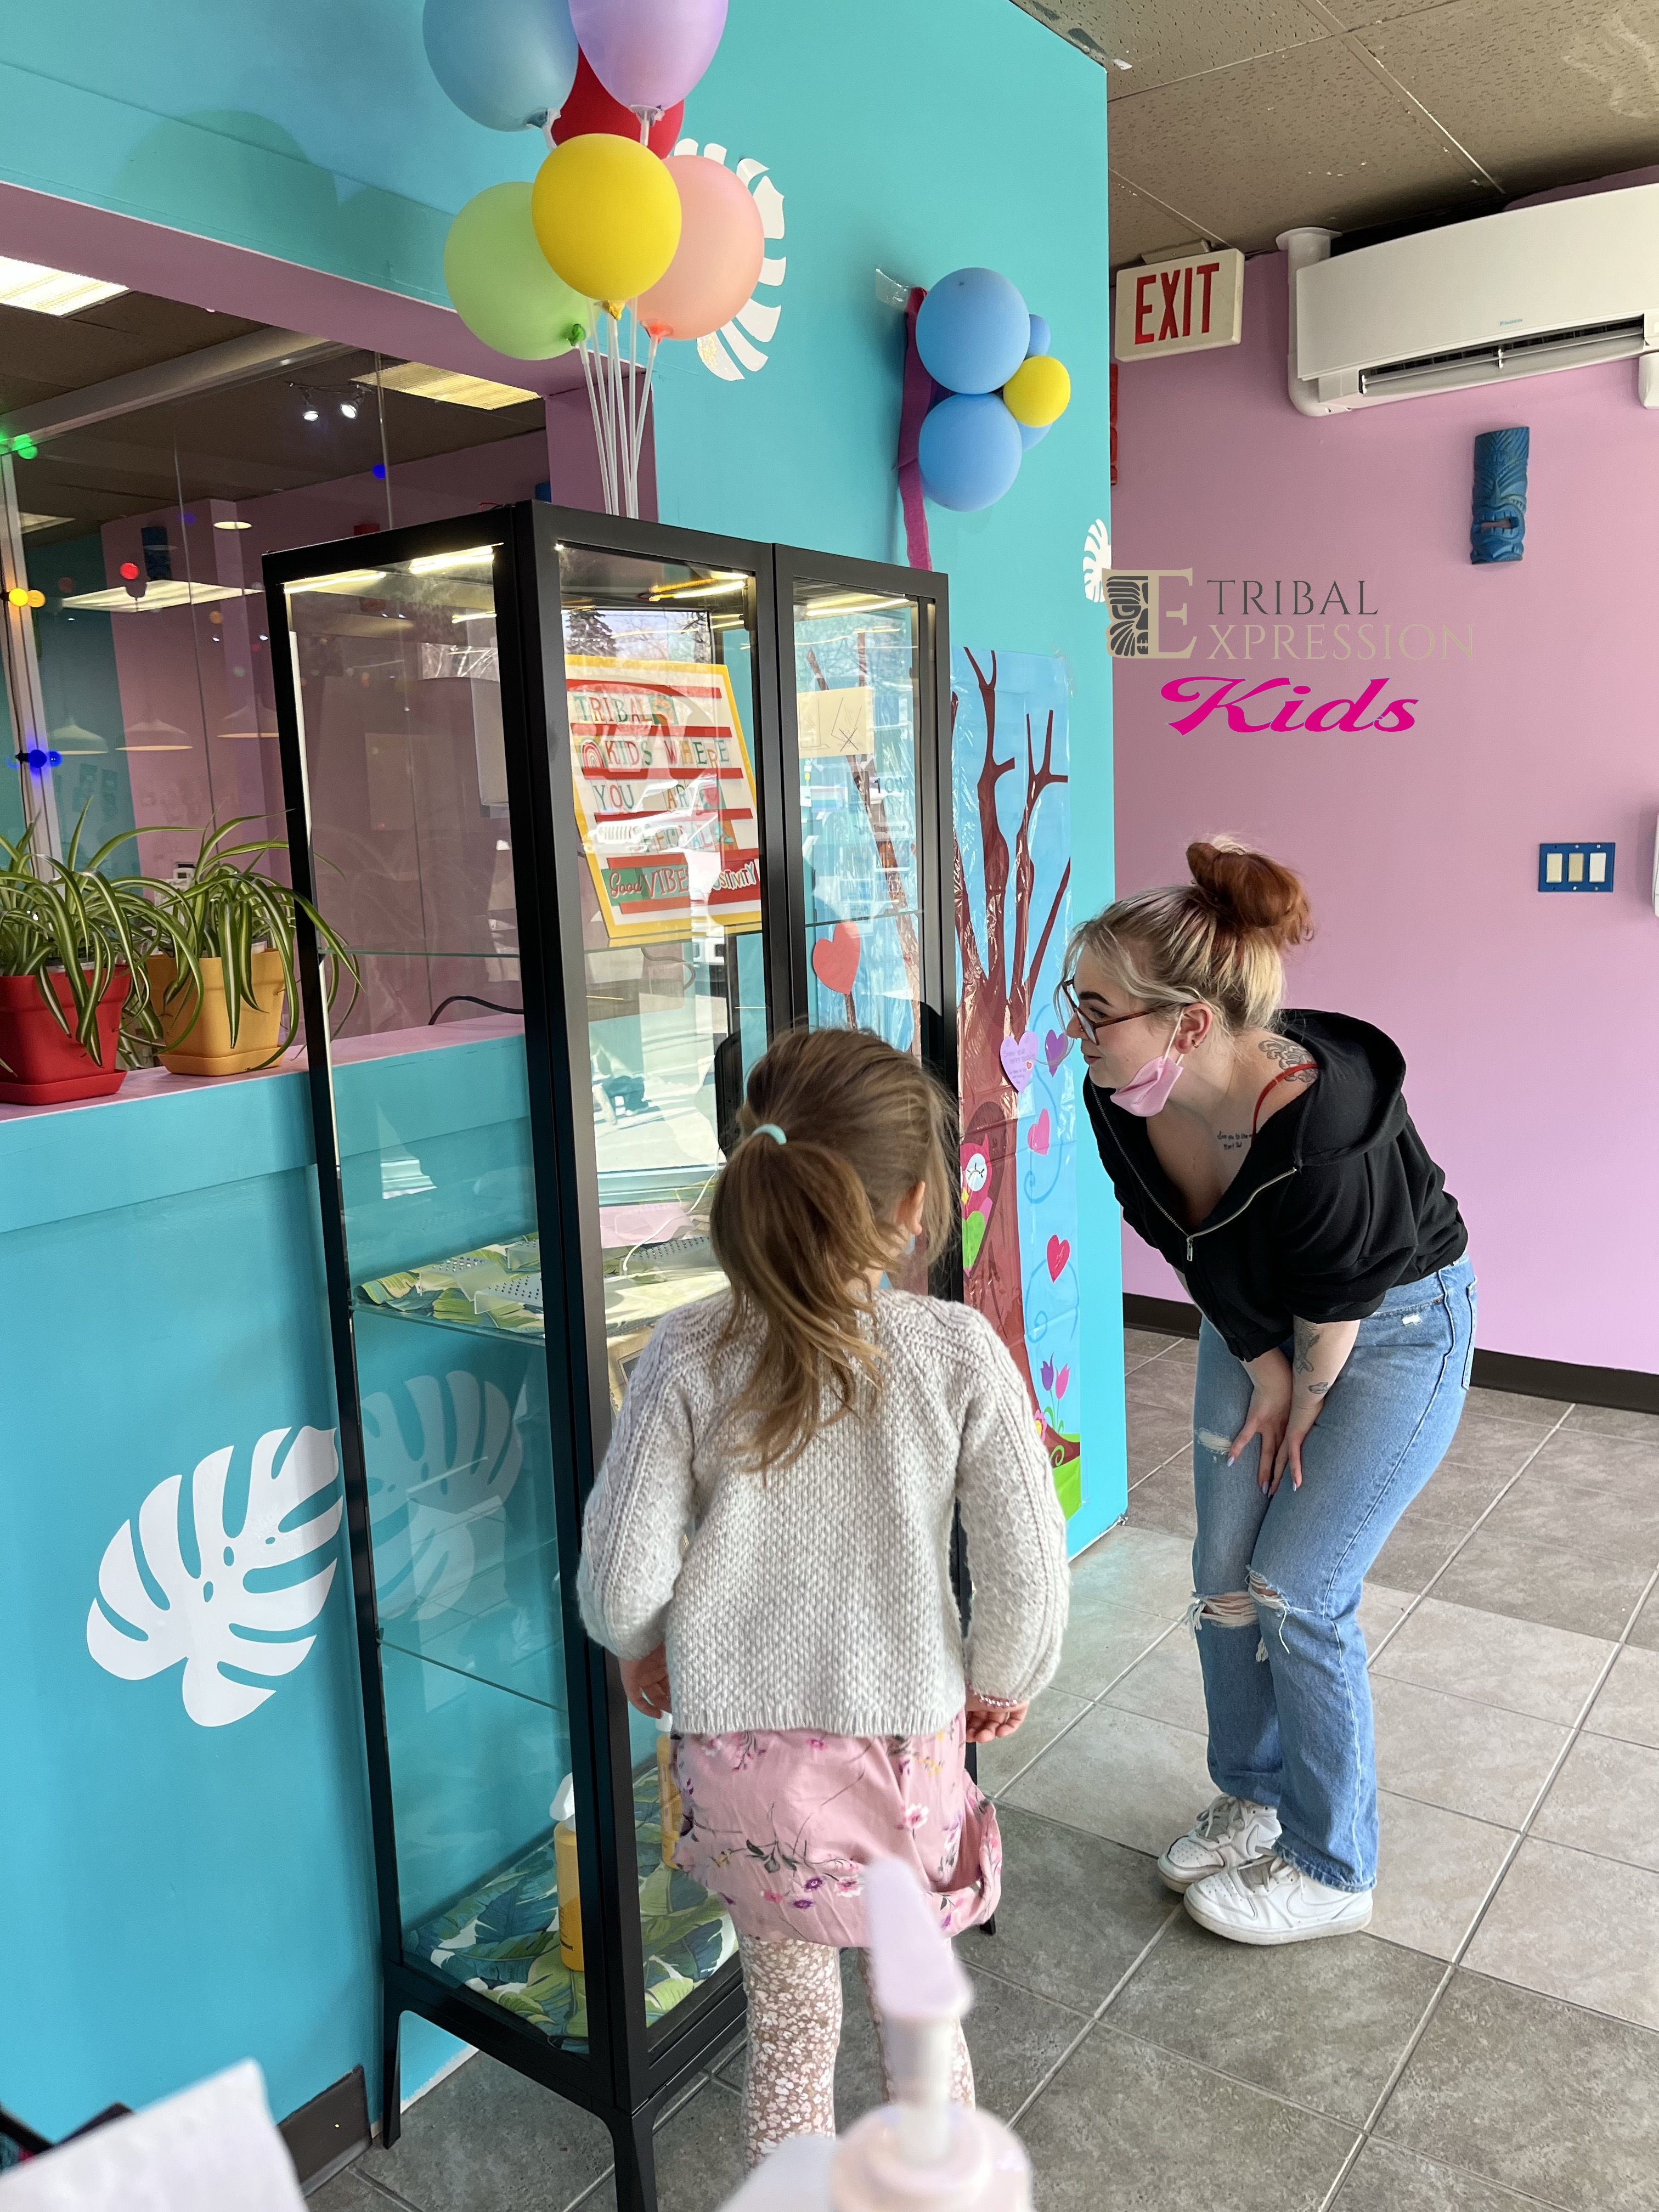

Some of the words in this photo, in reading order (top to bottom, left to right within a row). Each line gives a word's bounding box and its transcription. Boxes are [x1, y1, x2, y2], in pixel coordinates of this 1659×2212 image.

[1135, 262, 1220, 345] EXIT
[574, 696, 653, 723] TRIBAL
[605, 741, 653, 766] KIDS
[664, 740, 730, 769] WHERE
[593, 784, 634, 810] YOU
[609, 870, 643, 899] Good
[642, 867, 690, 898] VIBE
